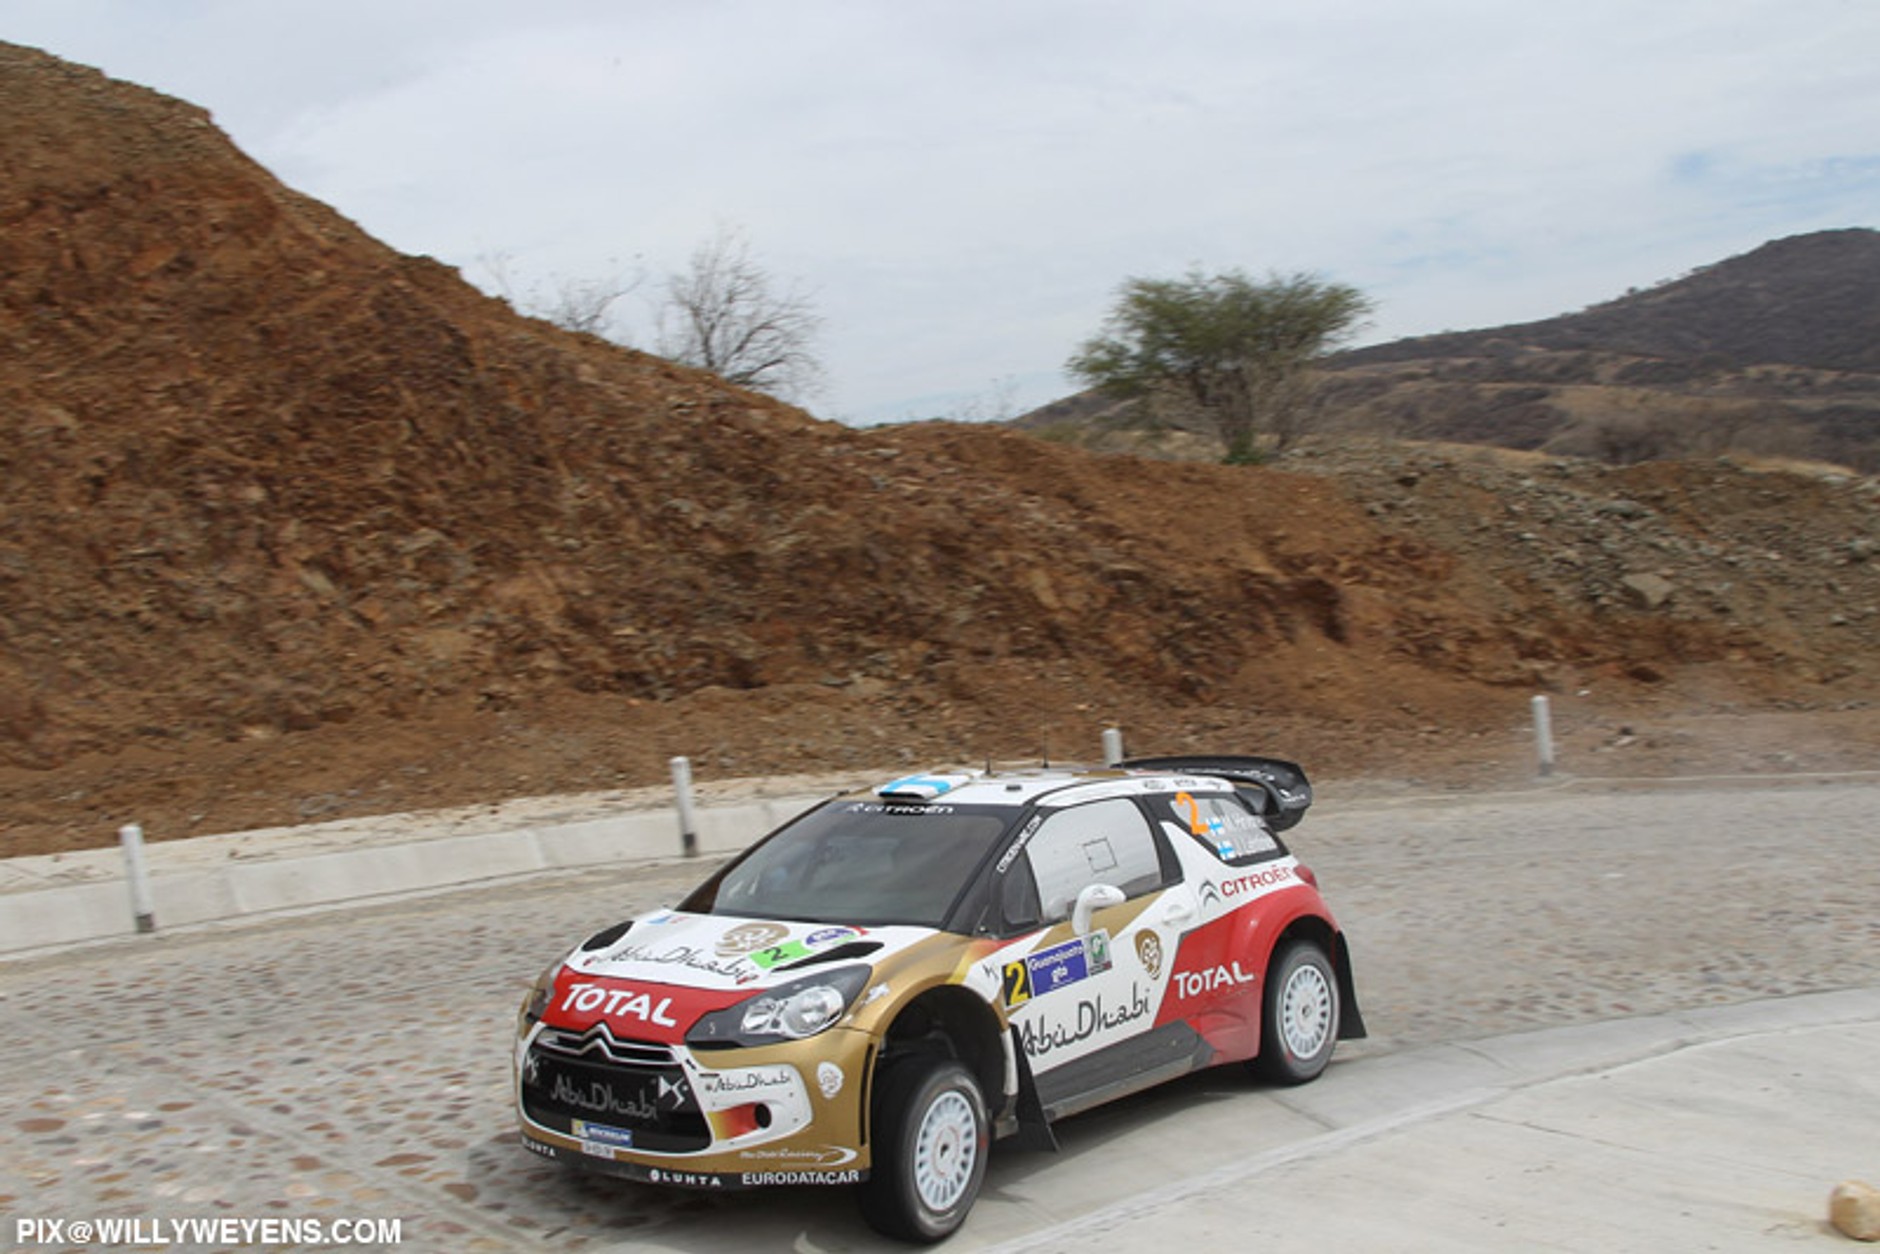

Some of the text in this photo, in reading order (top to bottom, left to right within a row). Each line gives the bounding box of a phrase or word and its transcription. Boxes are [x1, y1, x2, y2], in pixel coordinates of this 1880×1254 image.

[1175, 791, 1209, 835] 2
[763, 946, 789, 962] 2
[1005, 961, 1029, 1006] 2
[1173, 961, 1255, 1000] TOTAL
[561, 983, 677, 1027] TOTAL
[742, 1170, 859, 1186] EURODATACAR
